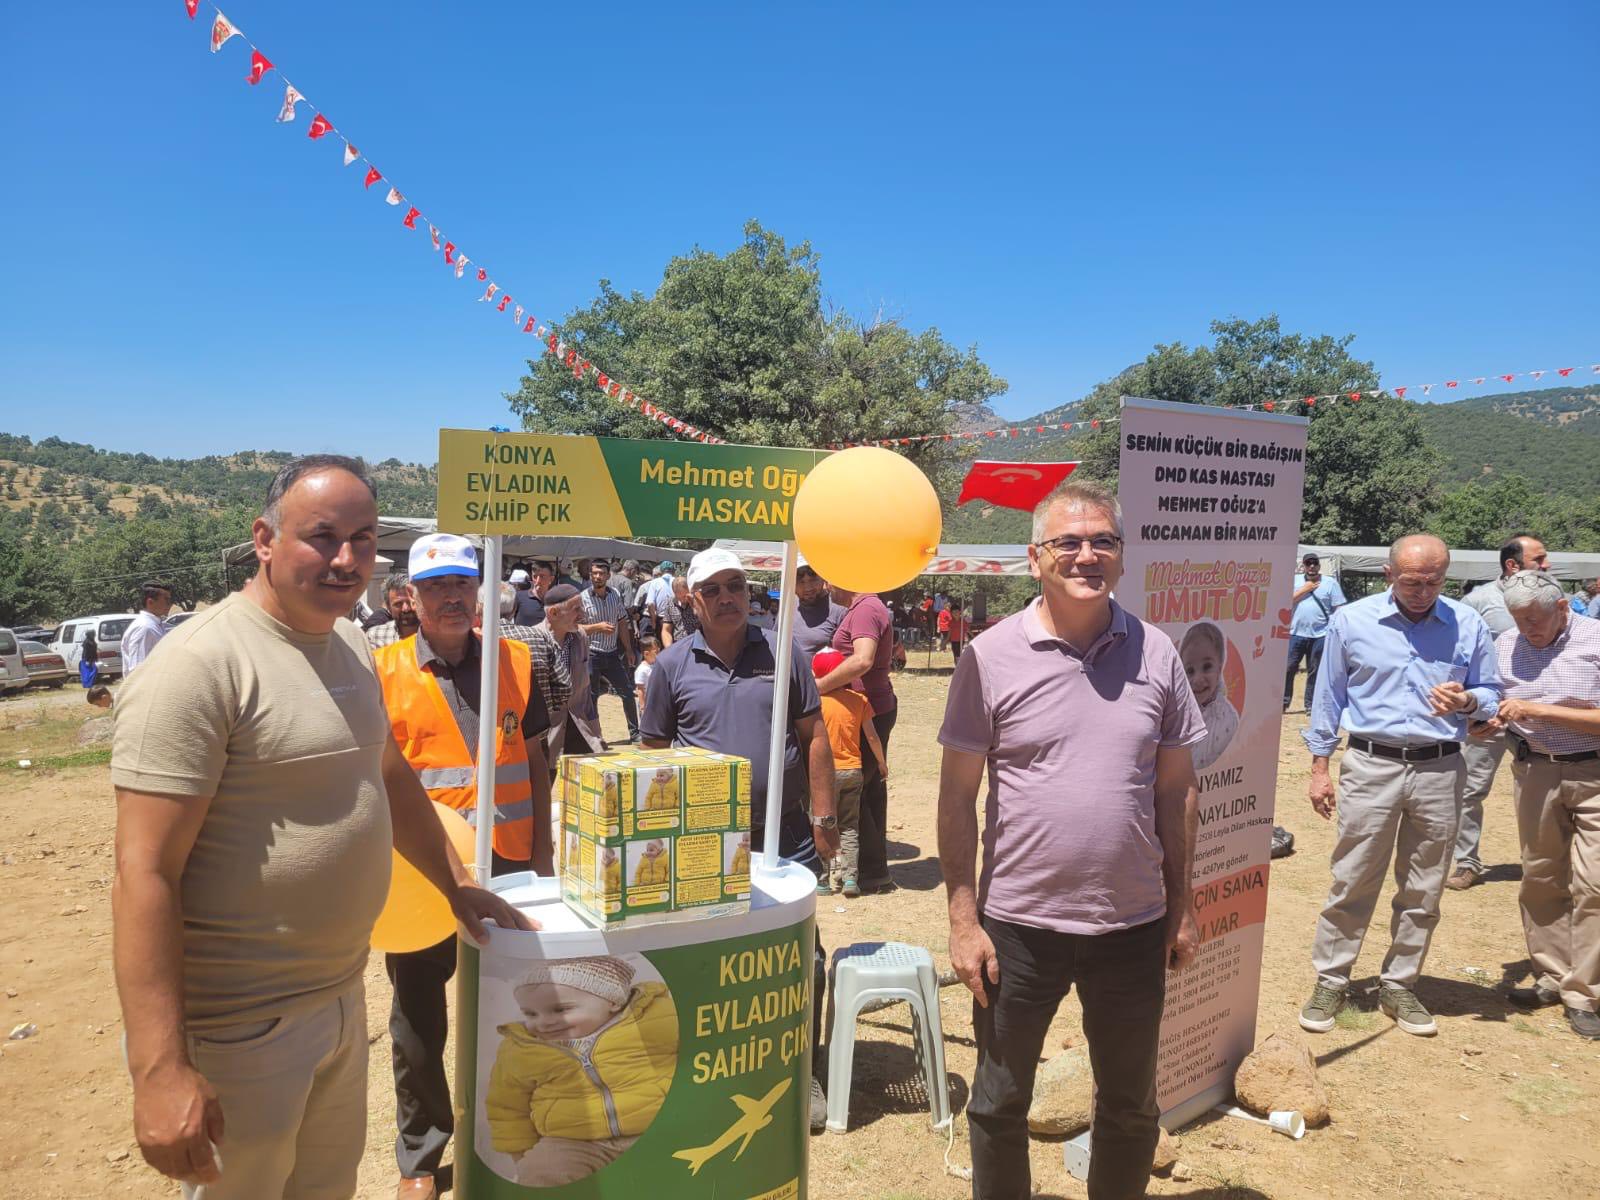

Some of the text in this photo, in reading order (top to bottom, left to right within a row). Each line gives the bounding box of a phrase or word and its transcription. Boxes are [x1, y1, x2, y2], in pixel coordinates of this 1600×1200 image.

[484, 444, 556, 466] KONYA
[1126, 431, 1303, 465] SENİN KÜÇÜK BİR BAĞIŞIN
[467, 472, 571, 495] EVLADINA
[640, 458, 754, 488] Mehmet
[1155, 466, 1275, 487] DMD KAS HASTASI
[465, 498, 571, 524] SAHİP ÇIK
[677, 497, 789, 526] HASKAN
[1158, 494, 1267, 514] MEHMET OĞUZ'A
[1141, 521, 1278, 541] KOCAMAN BİR HAYAT
[1151, 560, 1223, 587] Mehmet
[1150, 586, 1262, 623] UMUT OL
[1198, 766, 1243, 793] NYAMIZ
[1198, 795, 1257, 827] NAYLIDIR
[1222, 870, 1264, 899] SANA
[1209, 912, 1239, 938] VAR
[719, 940, 801, 987] KONYA
[695, 981, 811, 1038] EVLADINA
[692, 1022, 810, 1084] SAHİP ÇIK
